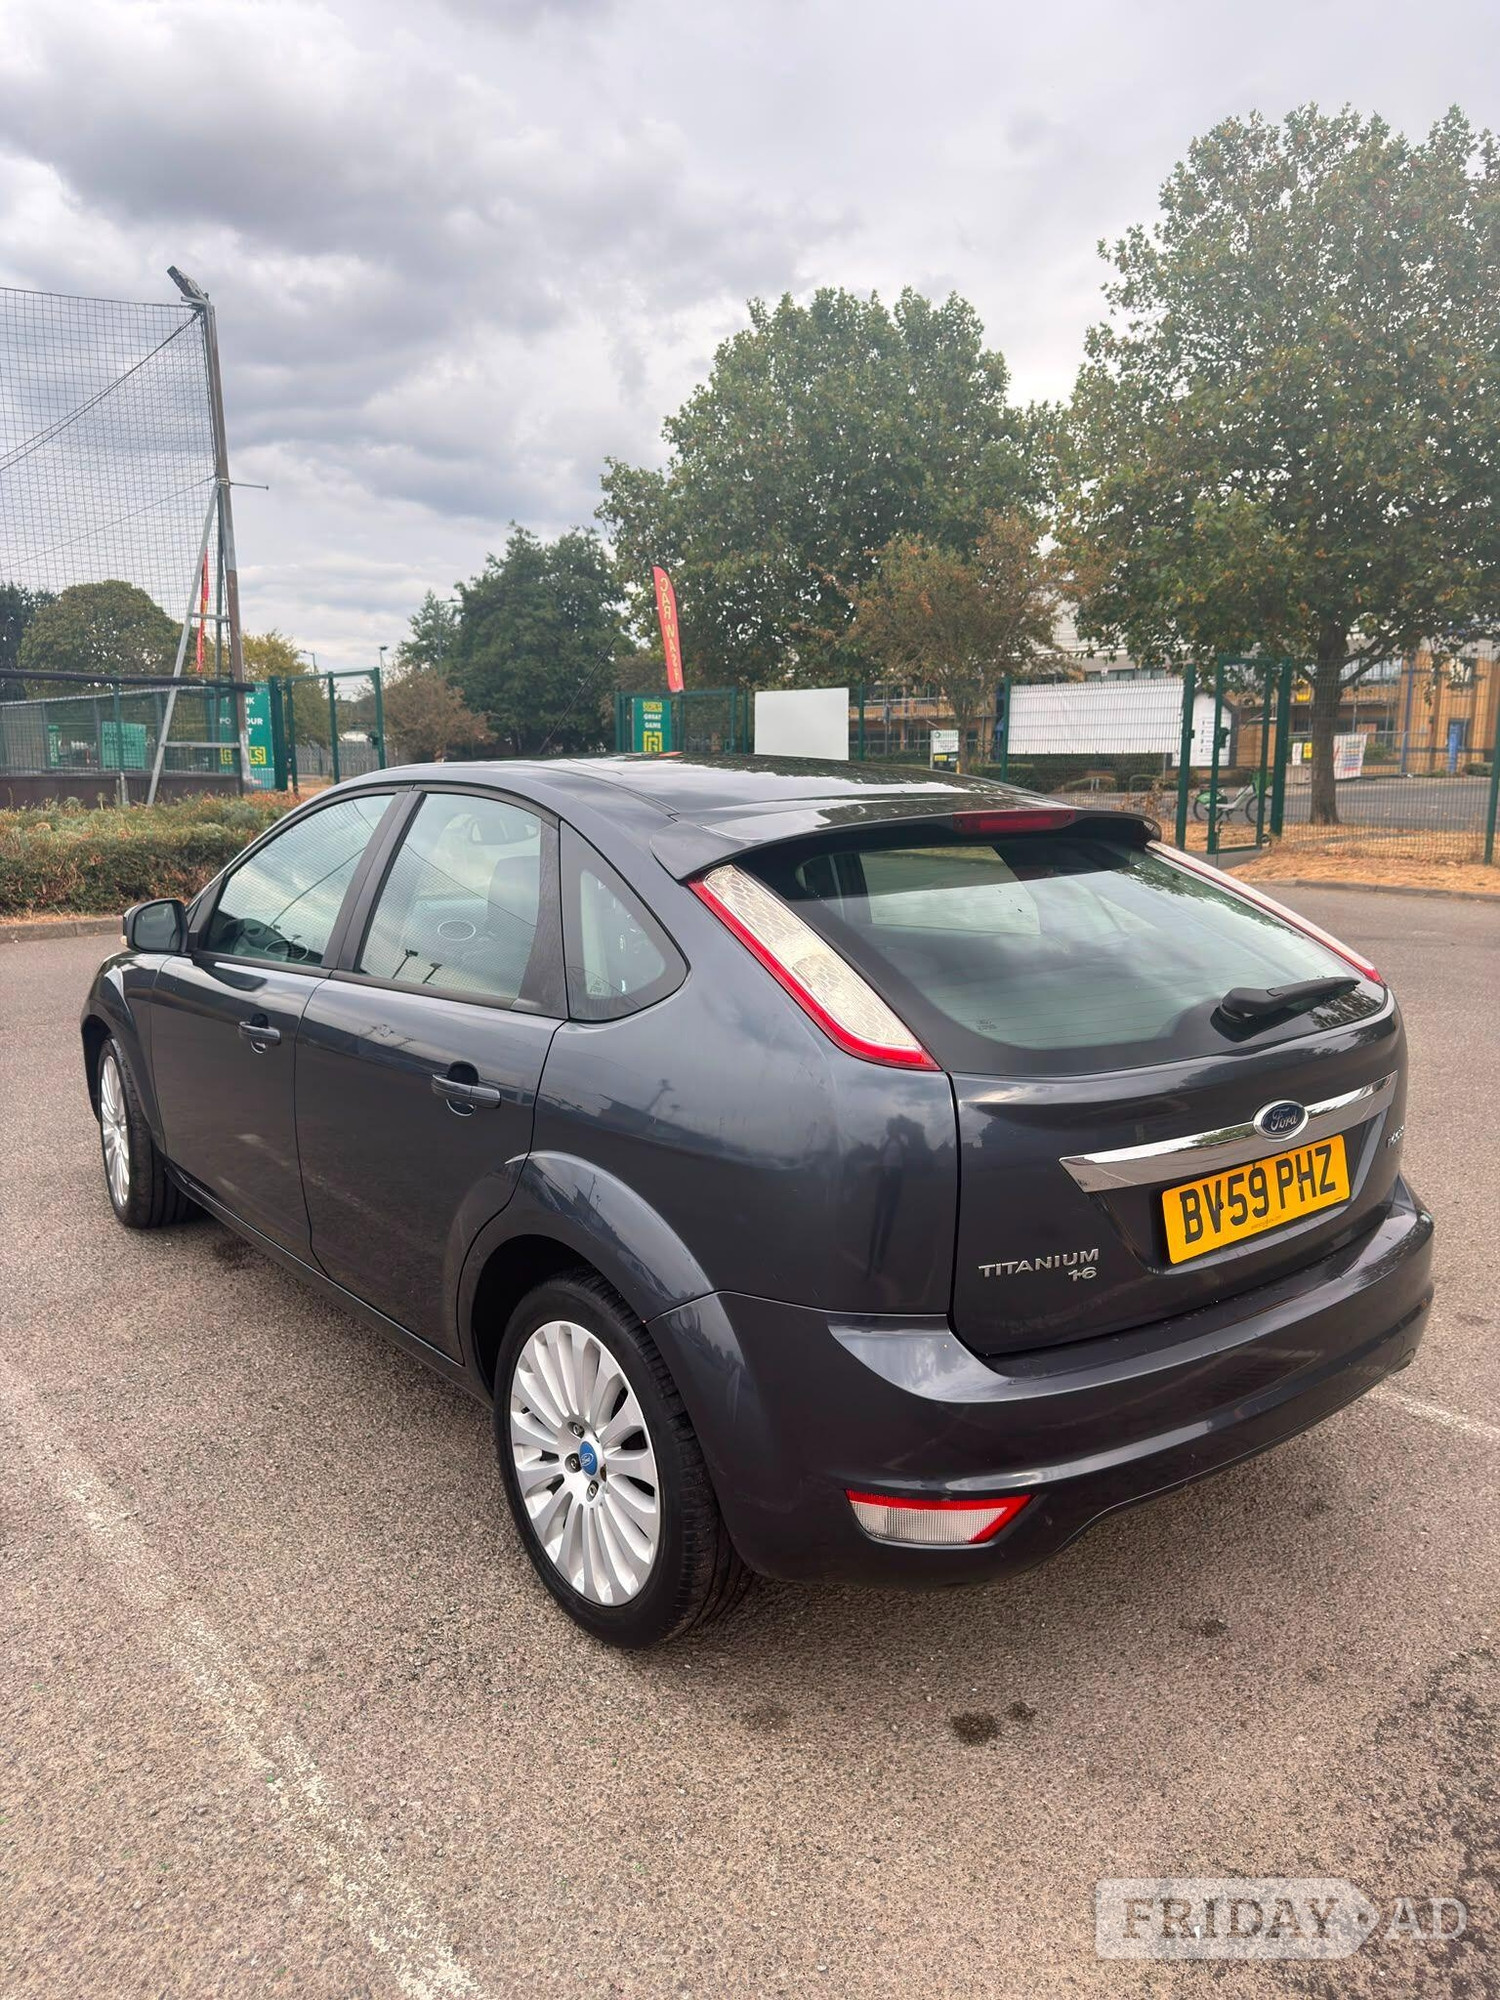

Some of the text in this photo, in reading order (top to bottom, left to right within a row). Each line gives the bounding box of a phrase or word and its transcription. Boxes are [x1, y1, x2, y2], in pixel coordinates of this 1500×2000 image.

[223, 748, 264, 762] GLS
[1270, 1107, 1298, 1131] Ford
[1180, 1144, 1336, 1244] BV59 PHZ
[978, 1248, 1099, 1278] TITANIUM
